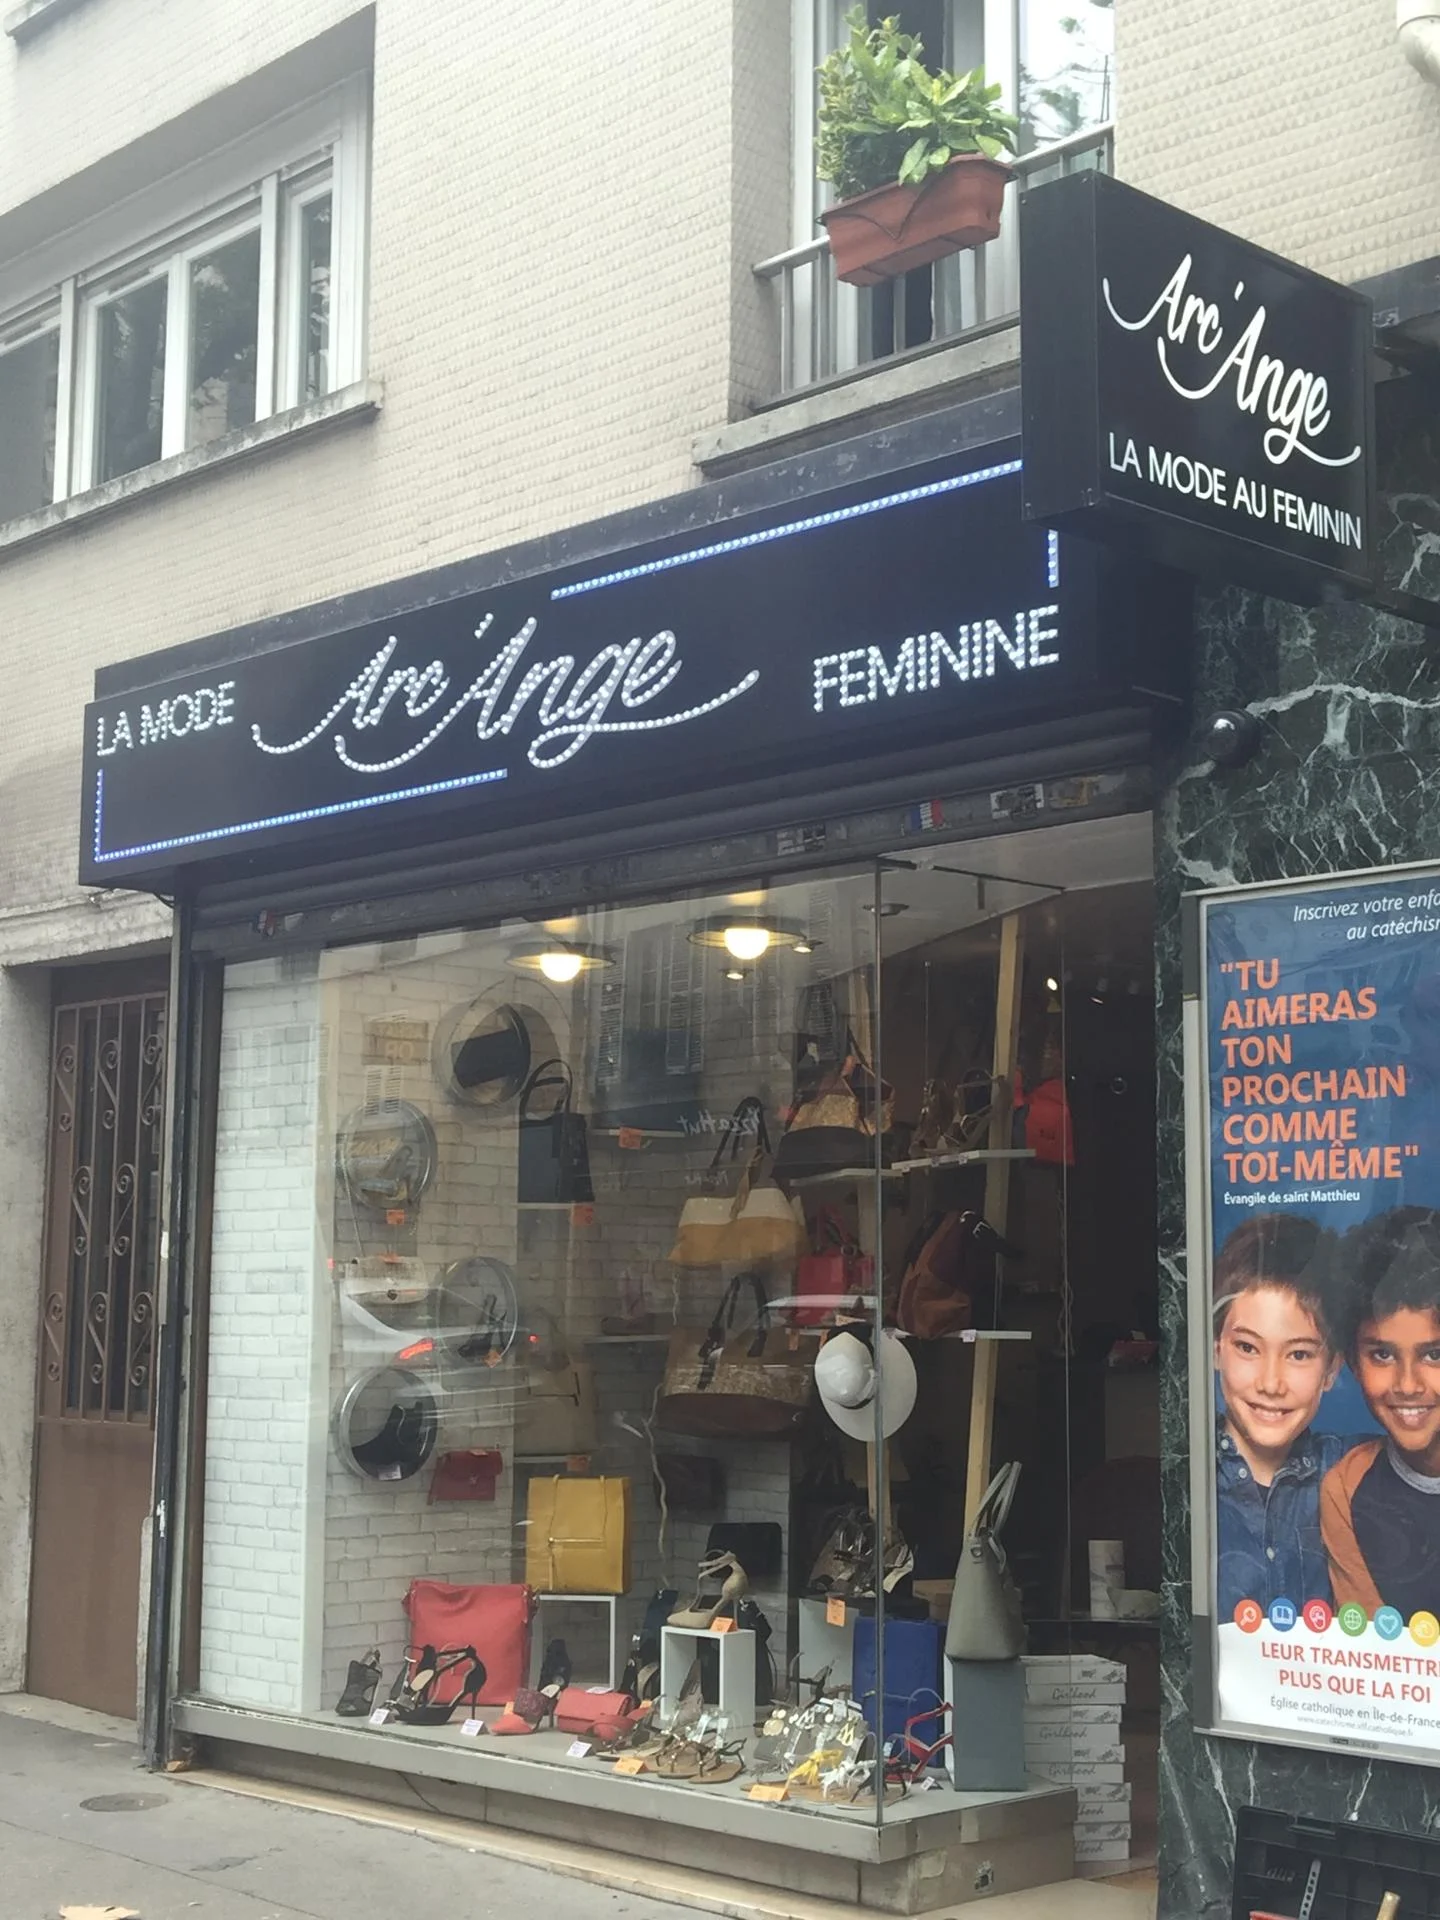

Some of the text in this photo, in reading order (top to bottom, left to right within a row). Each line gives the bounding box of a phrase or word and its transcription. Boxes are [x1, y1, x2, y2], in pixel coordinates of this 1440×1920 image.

[1109, 431, 1362, 550] LA MODE AU FEMININ
[813, 604, 1059, 712] FEMININE
[97, 680, 235, 757] LA MODE
[1293, 901, 1359, 922] Inscrivez
[1363, 897, 1403, 914] votre
[1346, 926, 1367, 940] au
[1220, 958, 1279, 991] "TU
[1220, 987, 1377, 1031] AIMERAS
[1220, 1034, 1292, 1068] TON
[1222, 1065, 1406, 1107] PROCHAIN
[1223, 1108, 1357, 1145] COMME
[1223, 1138, 1420, 1184] TOI-MÊME"
[1223, 1188, 1360, 1207] Évangile de saint Matthieu
[1261, 1641, 1305, 1662] LEUR
[1279, 1669, 1431, 1704] PLUS QUE LA FOI
[1270, 1695, 1299, 1711] Église
[1301, 1699, 1354, 1718] catholique
[1357, 1709, 1370, 1719] en
